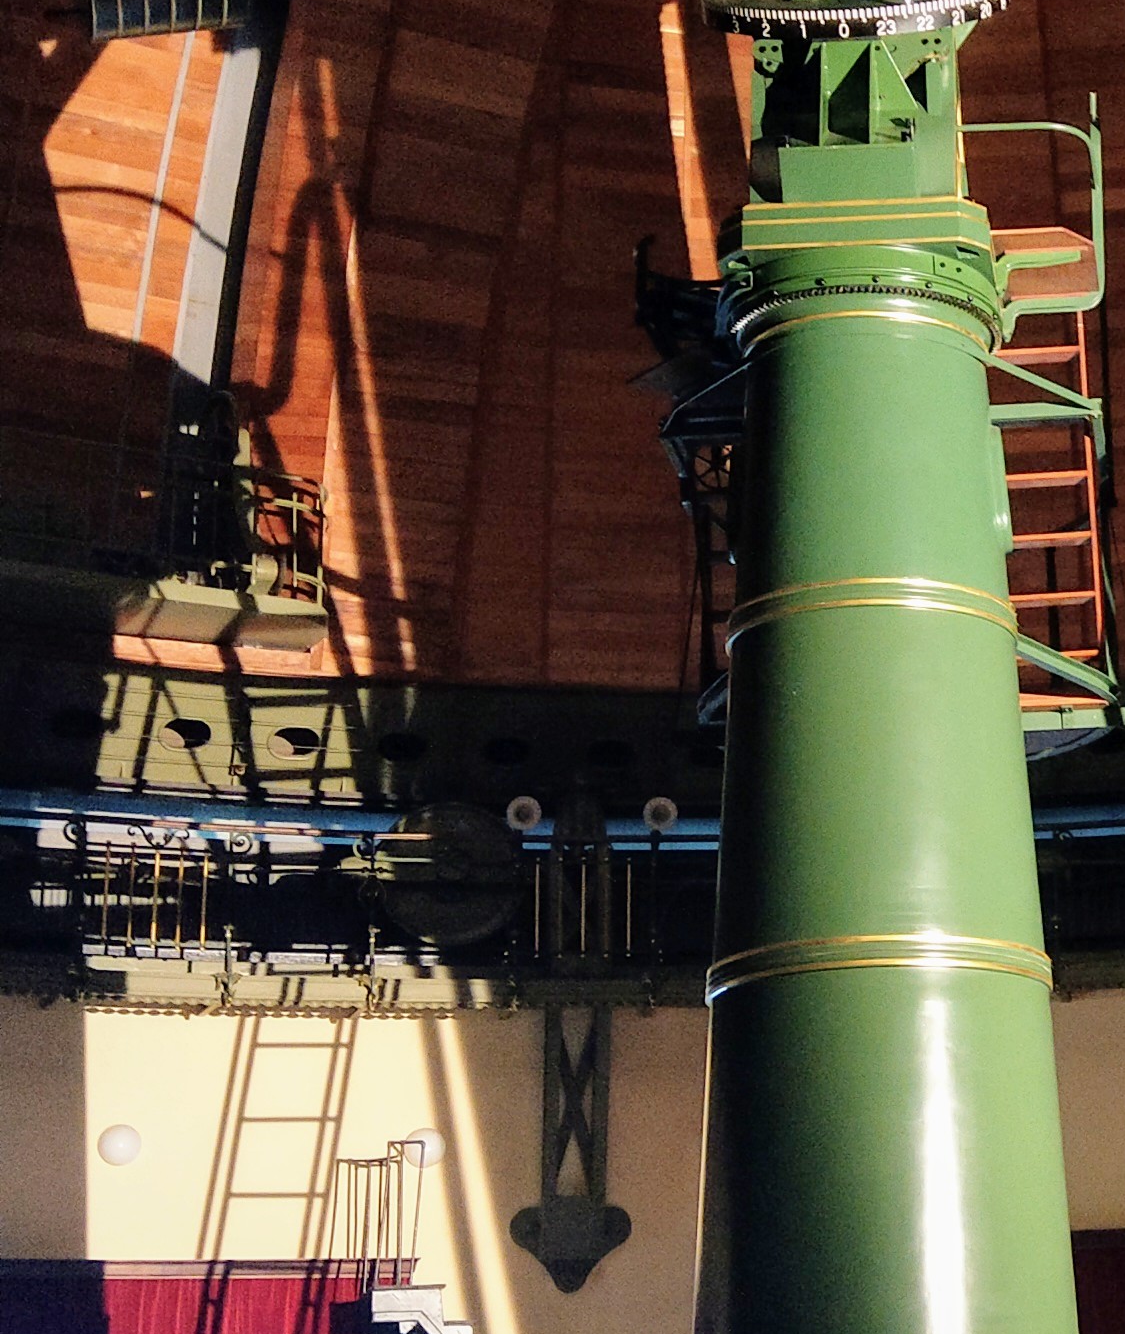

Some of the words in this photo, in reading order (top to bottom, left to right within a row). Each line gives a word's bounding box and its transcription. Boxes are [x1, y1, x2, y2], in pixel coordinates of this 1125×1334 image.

[732, 19, 740, 34] 3
[761, 22, 771, 38] 2
[800, 23, 807, 39] 1
[838, 23, 850, 39] 0
[876, 19, 897, 36] 23
[916, 14, 935, 32] 22
[951, 8, 966, 26] 21
[979, 1, 993, 20] 20
